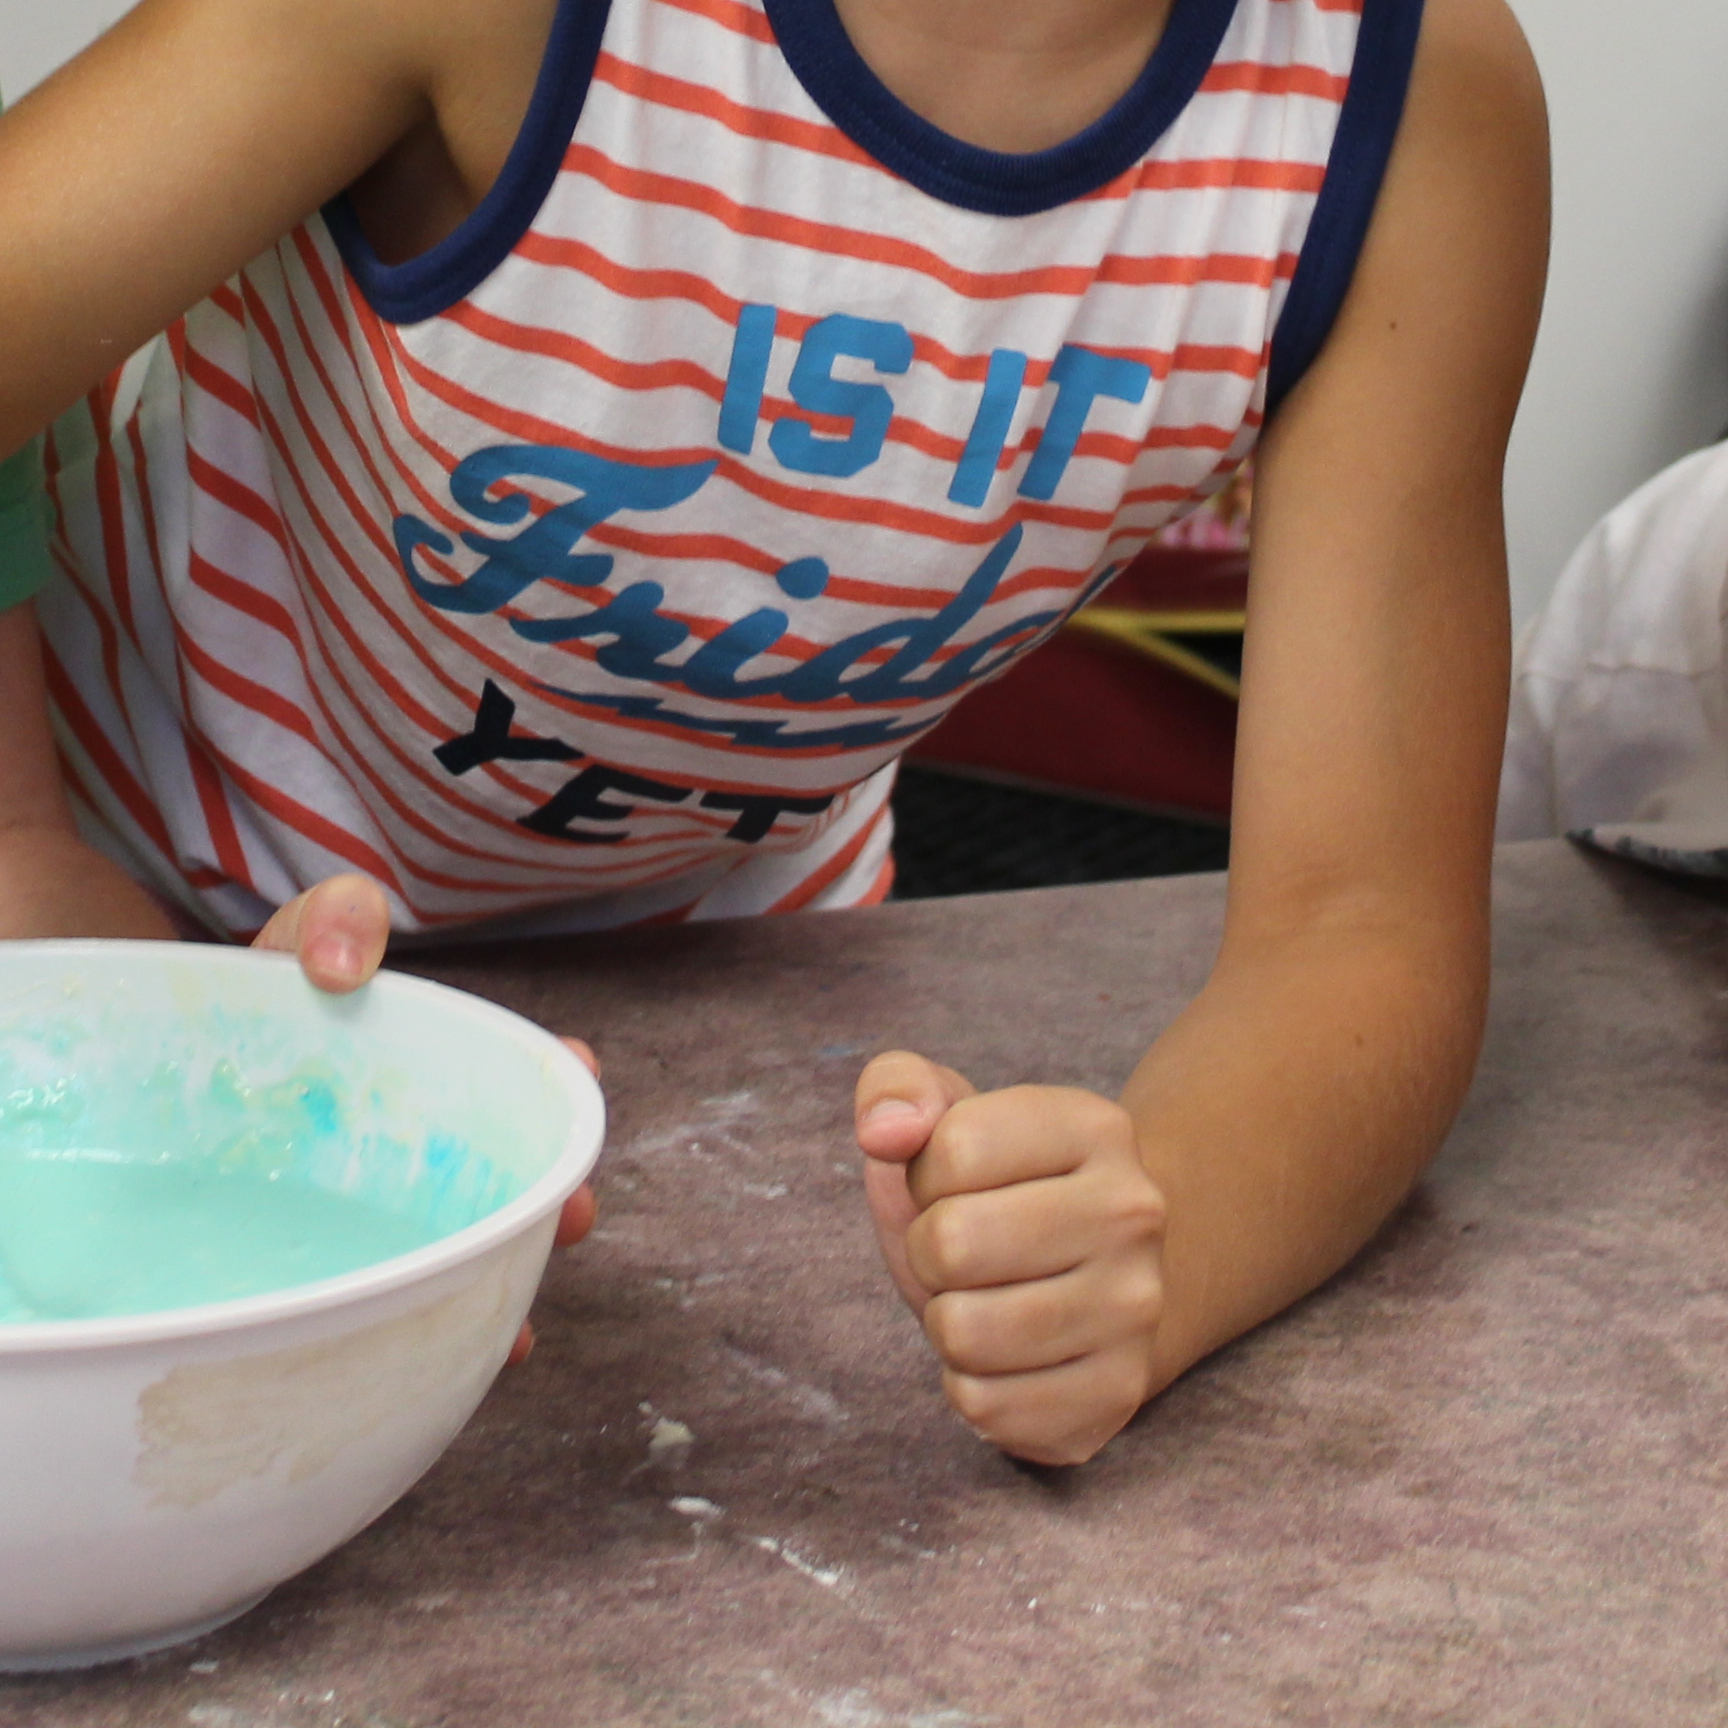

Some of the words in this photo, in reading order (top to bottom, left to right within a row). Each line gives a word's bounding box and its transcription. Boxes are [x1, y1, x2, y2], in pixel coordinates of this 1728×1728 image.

[717, 303, 914, 477] IS
[947, 343, 1152, 509] IT
[432, 677, 834, 845] YET
